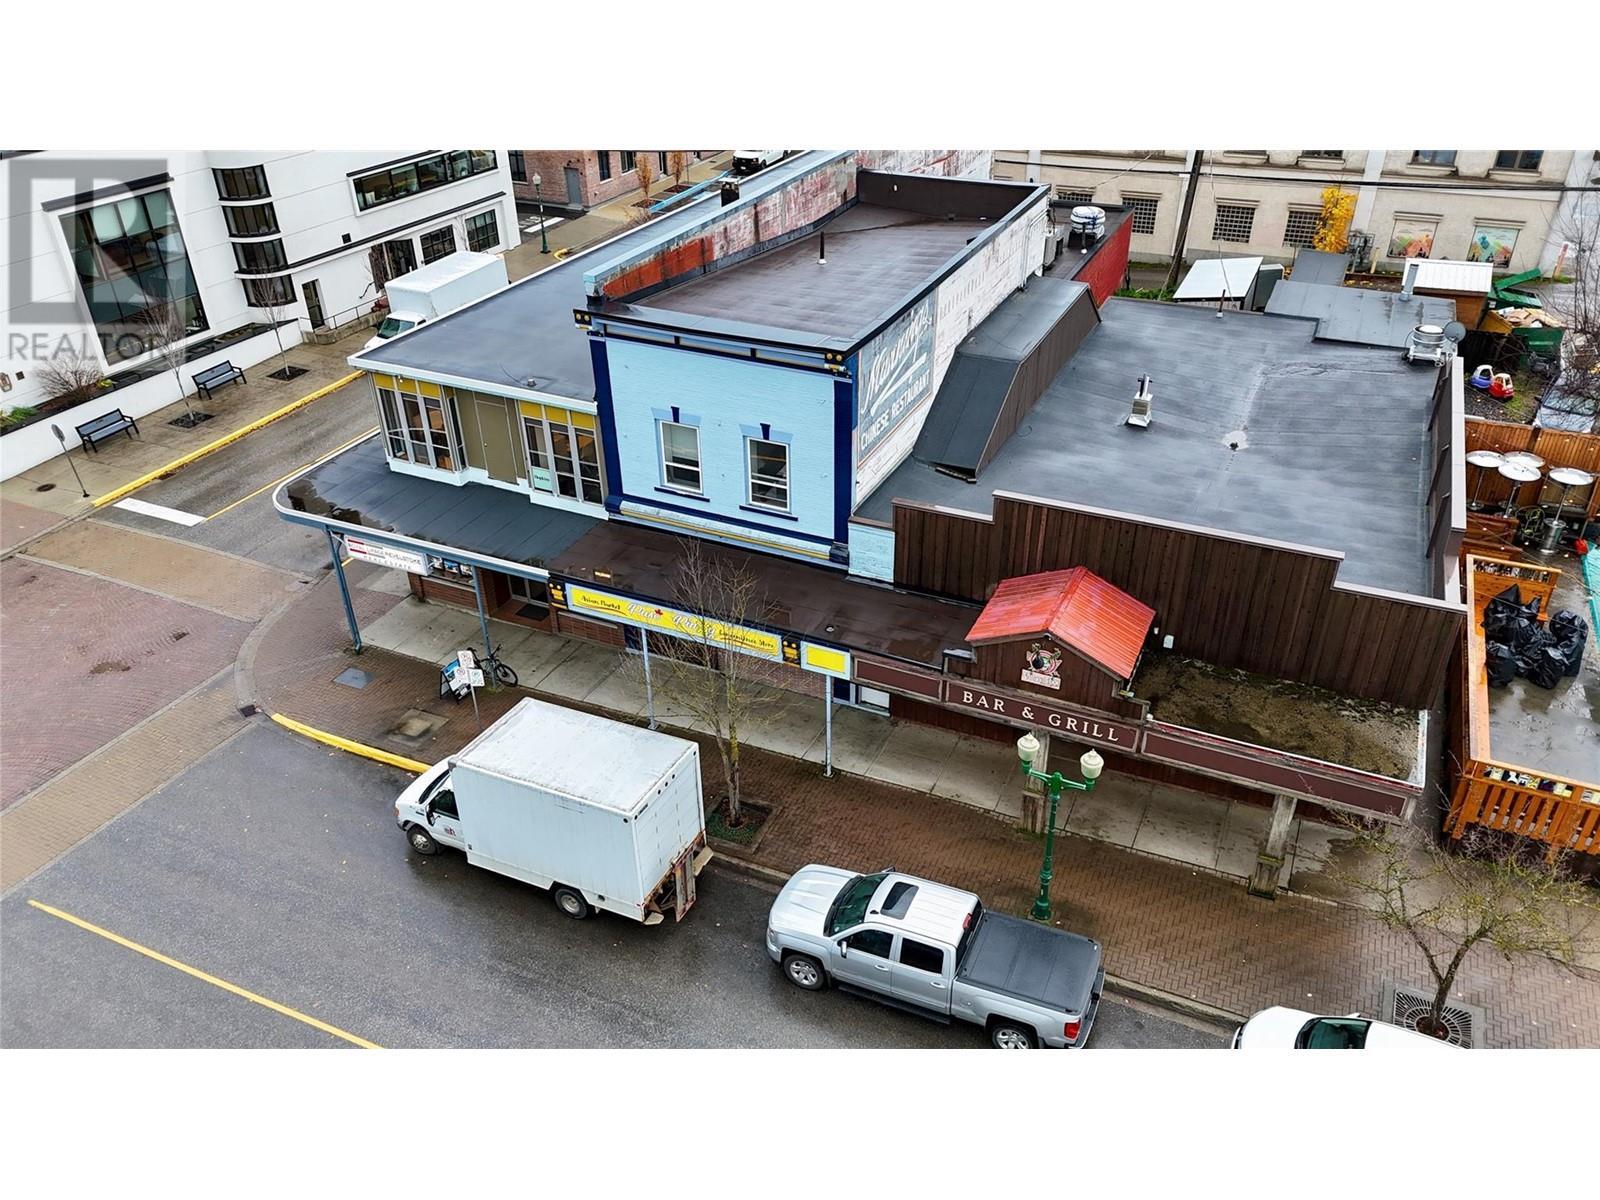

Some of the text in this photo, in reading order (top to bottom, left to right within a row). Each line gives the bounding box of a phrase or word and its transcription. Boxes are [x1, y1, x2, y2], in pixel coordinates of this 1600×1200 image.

[860, 368, 931, 451] CHINESE RESTAURANT
[963, 690, 1119, 742] BAR & GRILL
